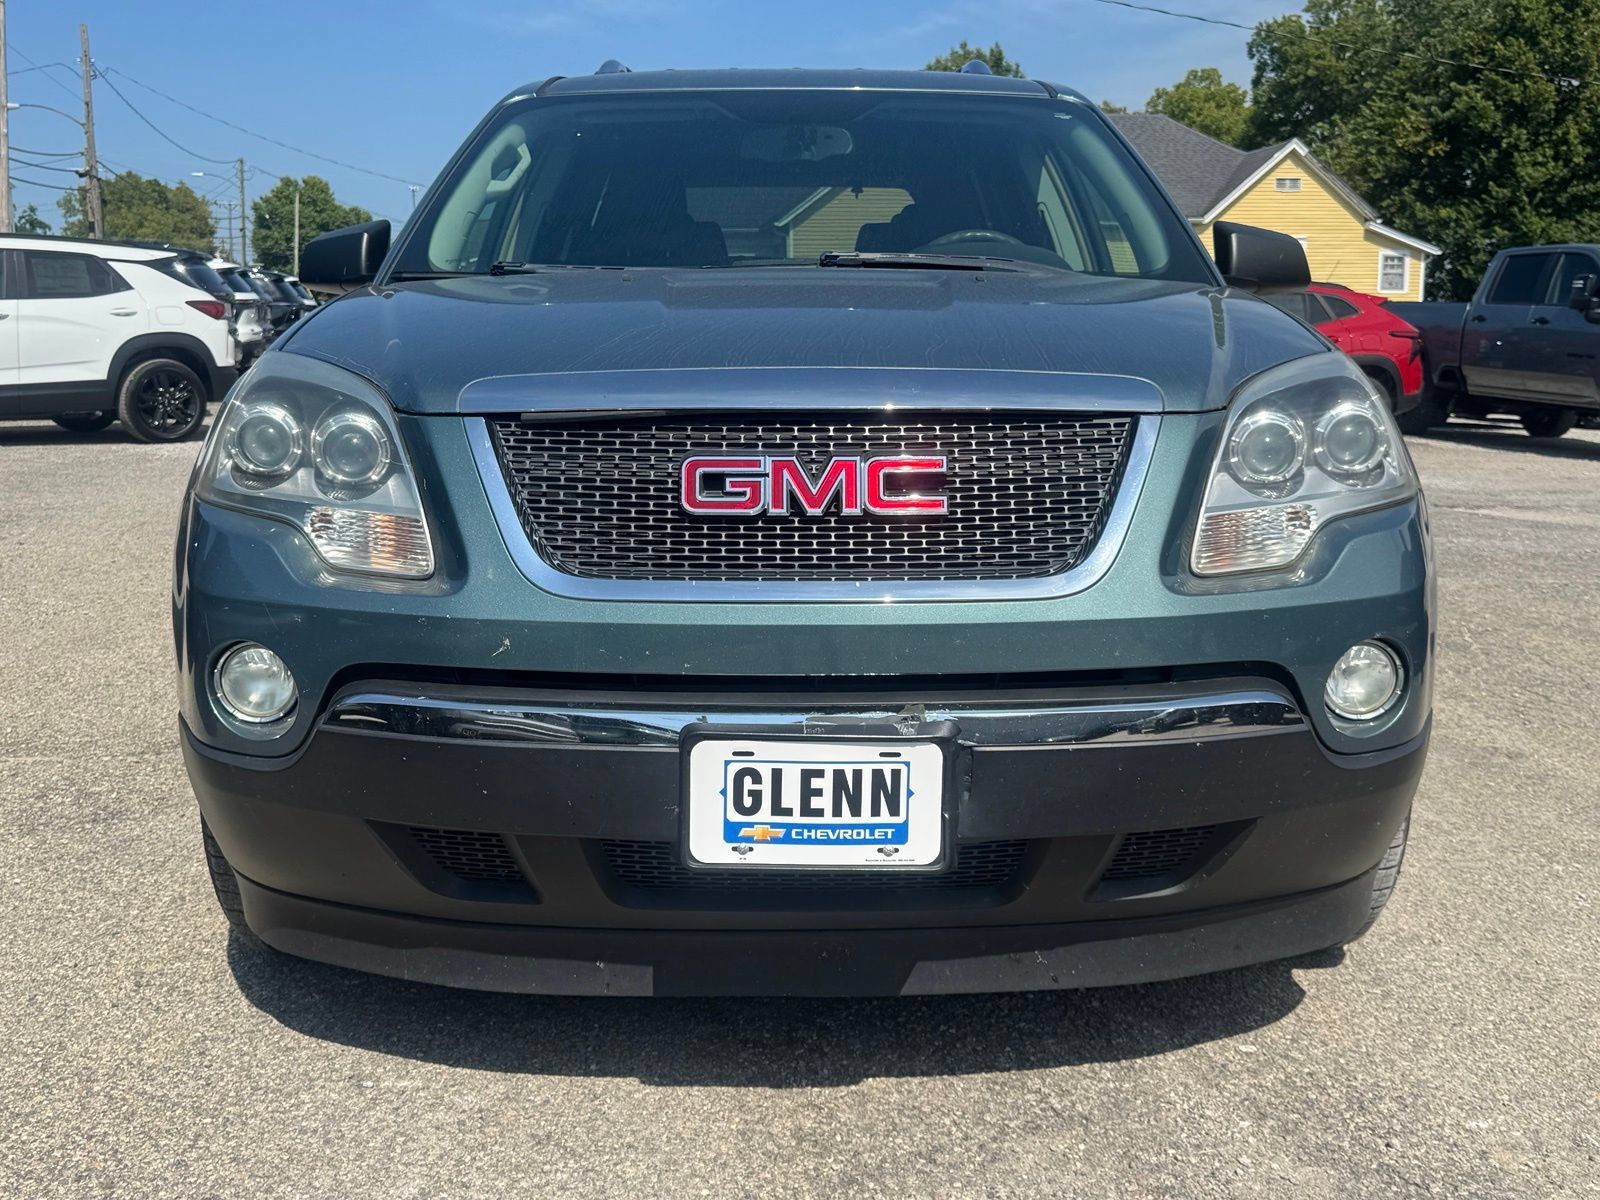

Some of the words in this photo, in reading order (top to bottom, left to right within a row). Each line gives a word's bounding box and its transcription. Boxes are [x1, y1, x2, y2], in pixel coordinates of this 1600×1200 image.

[681, 455, 949, 516] GMC
[732, 766, 902, 818] GLENN
[791, 828, 896, 840] CHEVROLET
